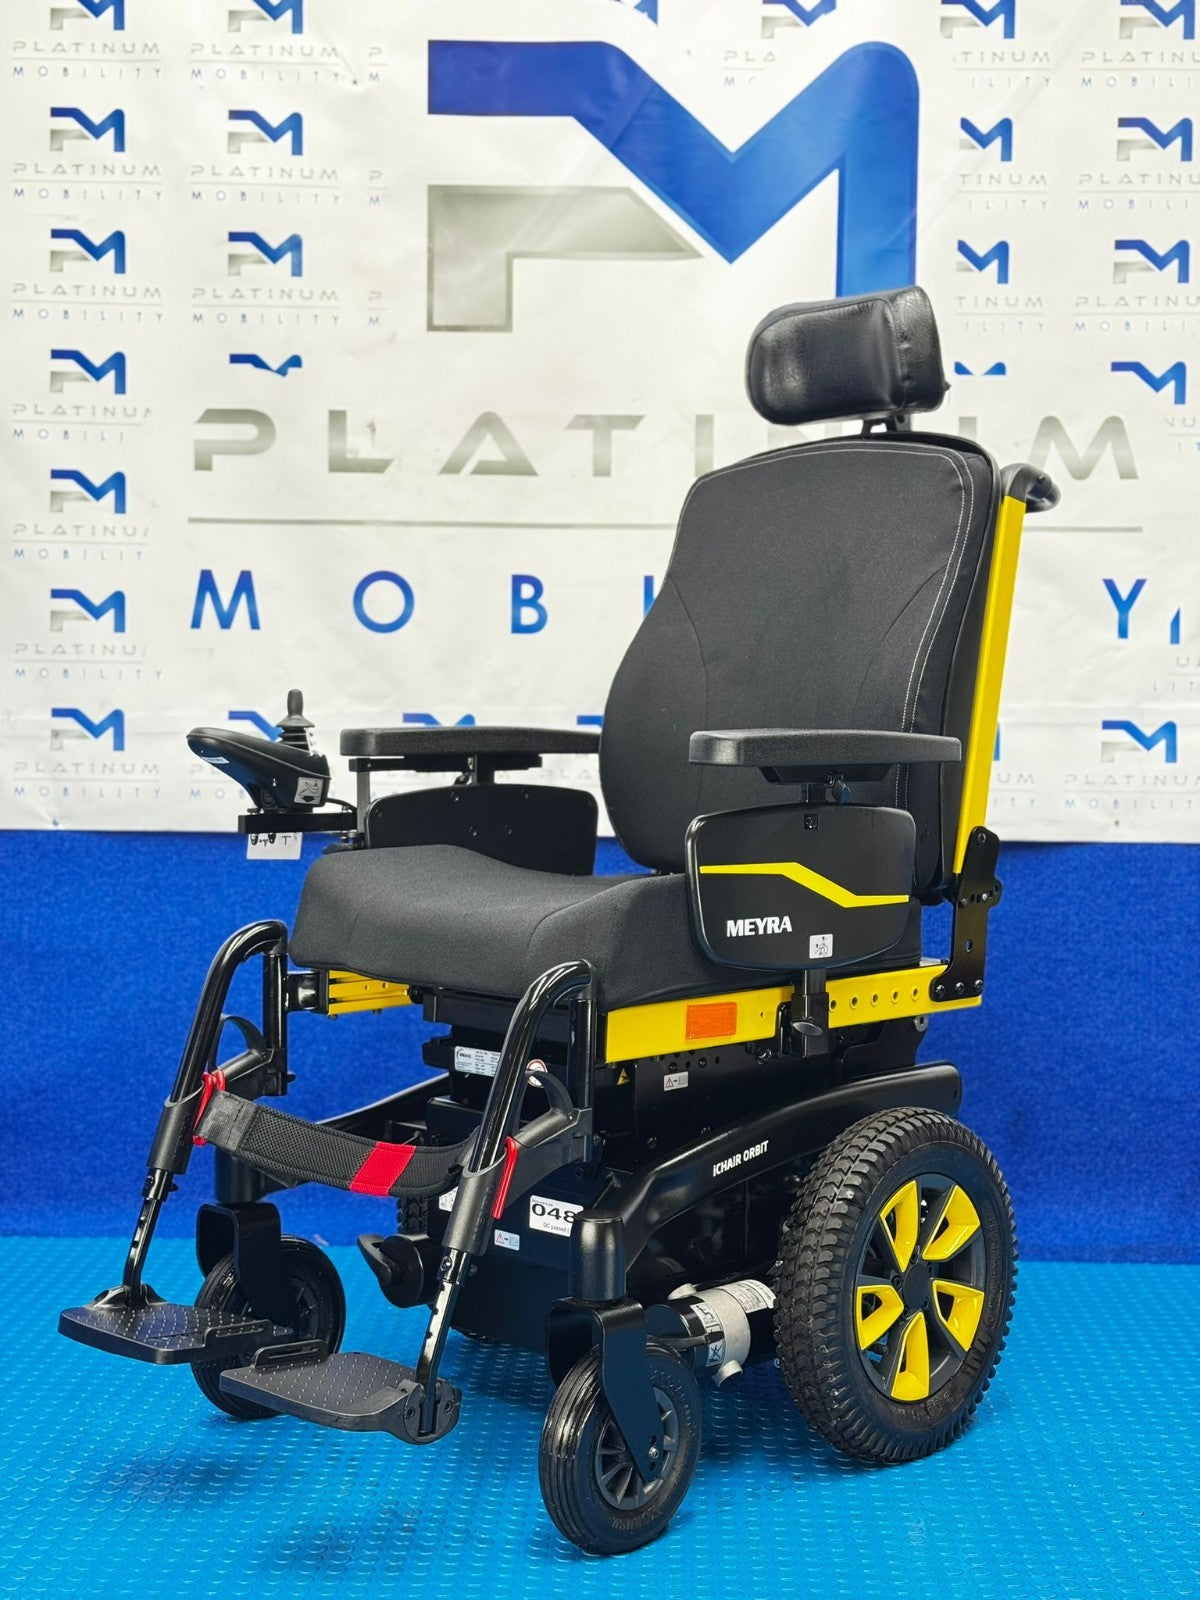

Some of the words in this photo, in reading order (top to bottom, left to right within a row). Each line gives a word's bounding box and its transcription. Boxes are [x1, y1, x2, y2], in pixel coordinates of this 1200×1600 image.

[13, 41, 160, 54] PLATINUM
[190, 43, 338, 57] PLATINUM
[952, 51, 1050, 62] TINUM
[13, 66, 161, 78] MOBILITY
[191, 69, 340, 81] MOBILITY
[14, 163, 160, 176] PLATINUM
[190, 165, 338, 180] PLATINUM
[13, 188, 161, 201] MOBILITY
[191, 190, 340, 203] MOBILITY
[13, 283, 161, 298] PLATINUM
[192, 288, 338, 301] PLATINUM
[13, 308, 162, 322] MOBILITY
[192, 313, 340, 325] MOBILITY
[13, 524, 148, 537] PLATINU
[15, 643, 147, 656] PLATINU
[15, 762, 160, 775] PLATINUM
[13, 787, 161, 798] MOBILITY
[726, 915, 792, 937] MEYRA
[712, 1153, 742, 1177] iCHAIR
[743, 1140, 769, 1162] ORBIT
